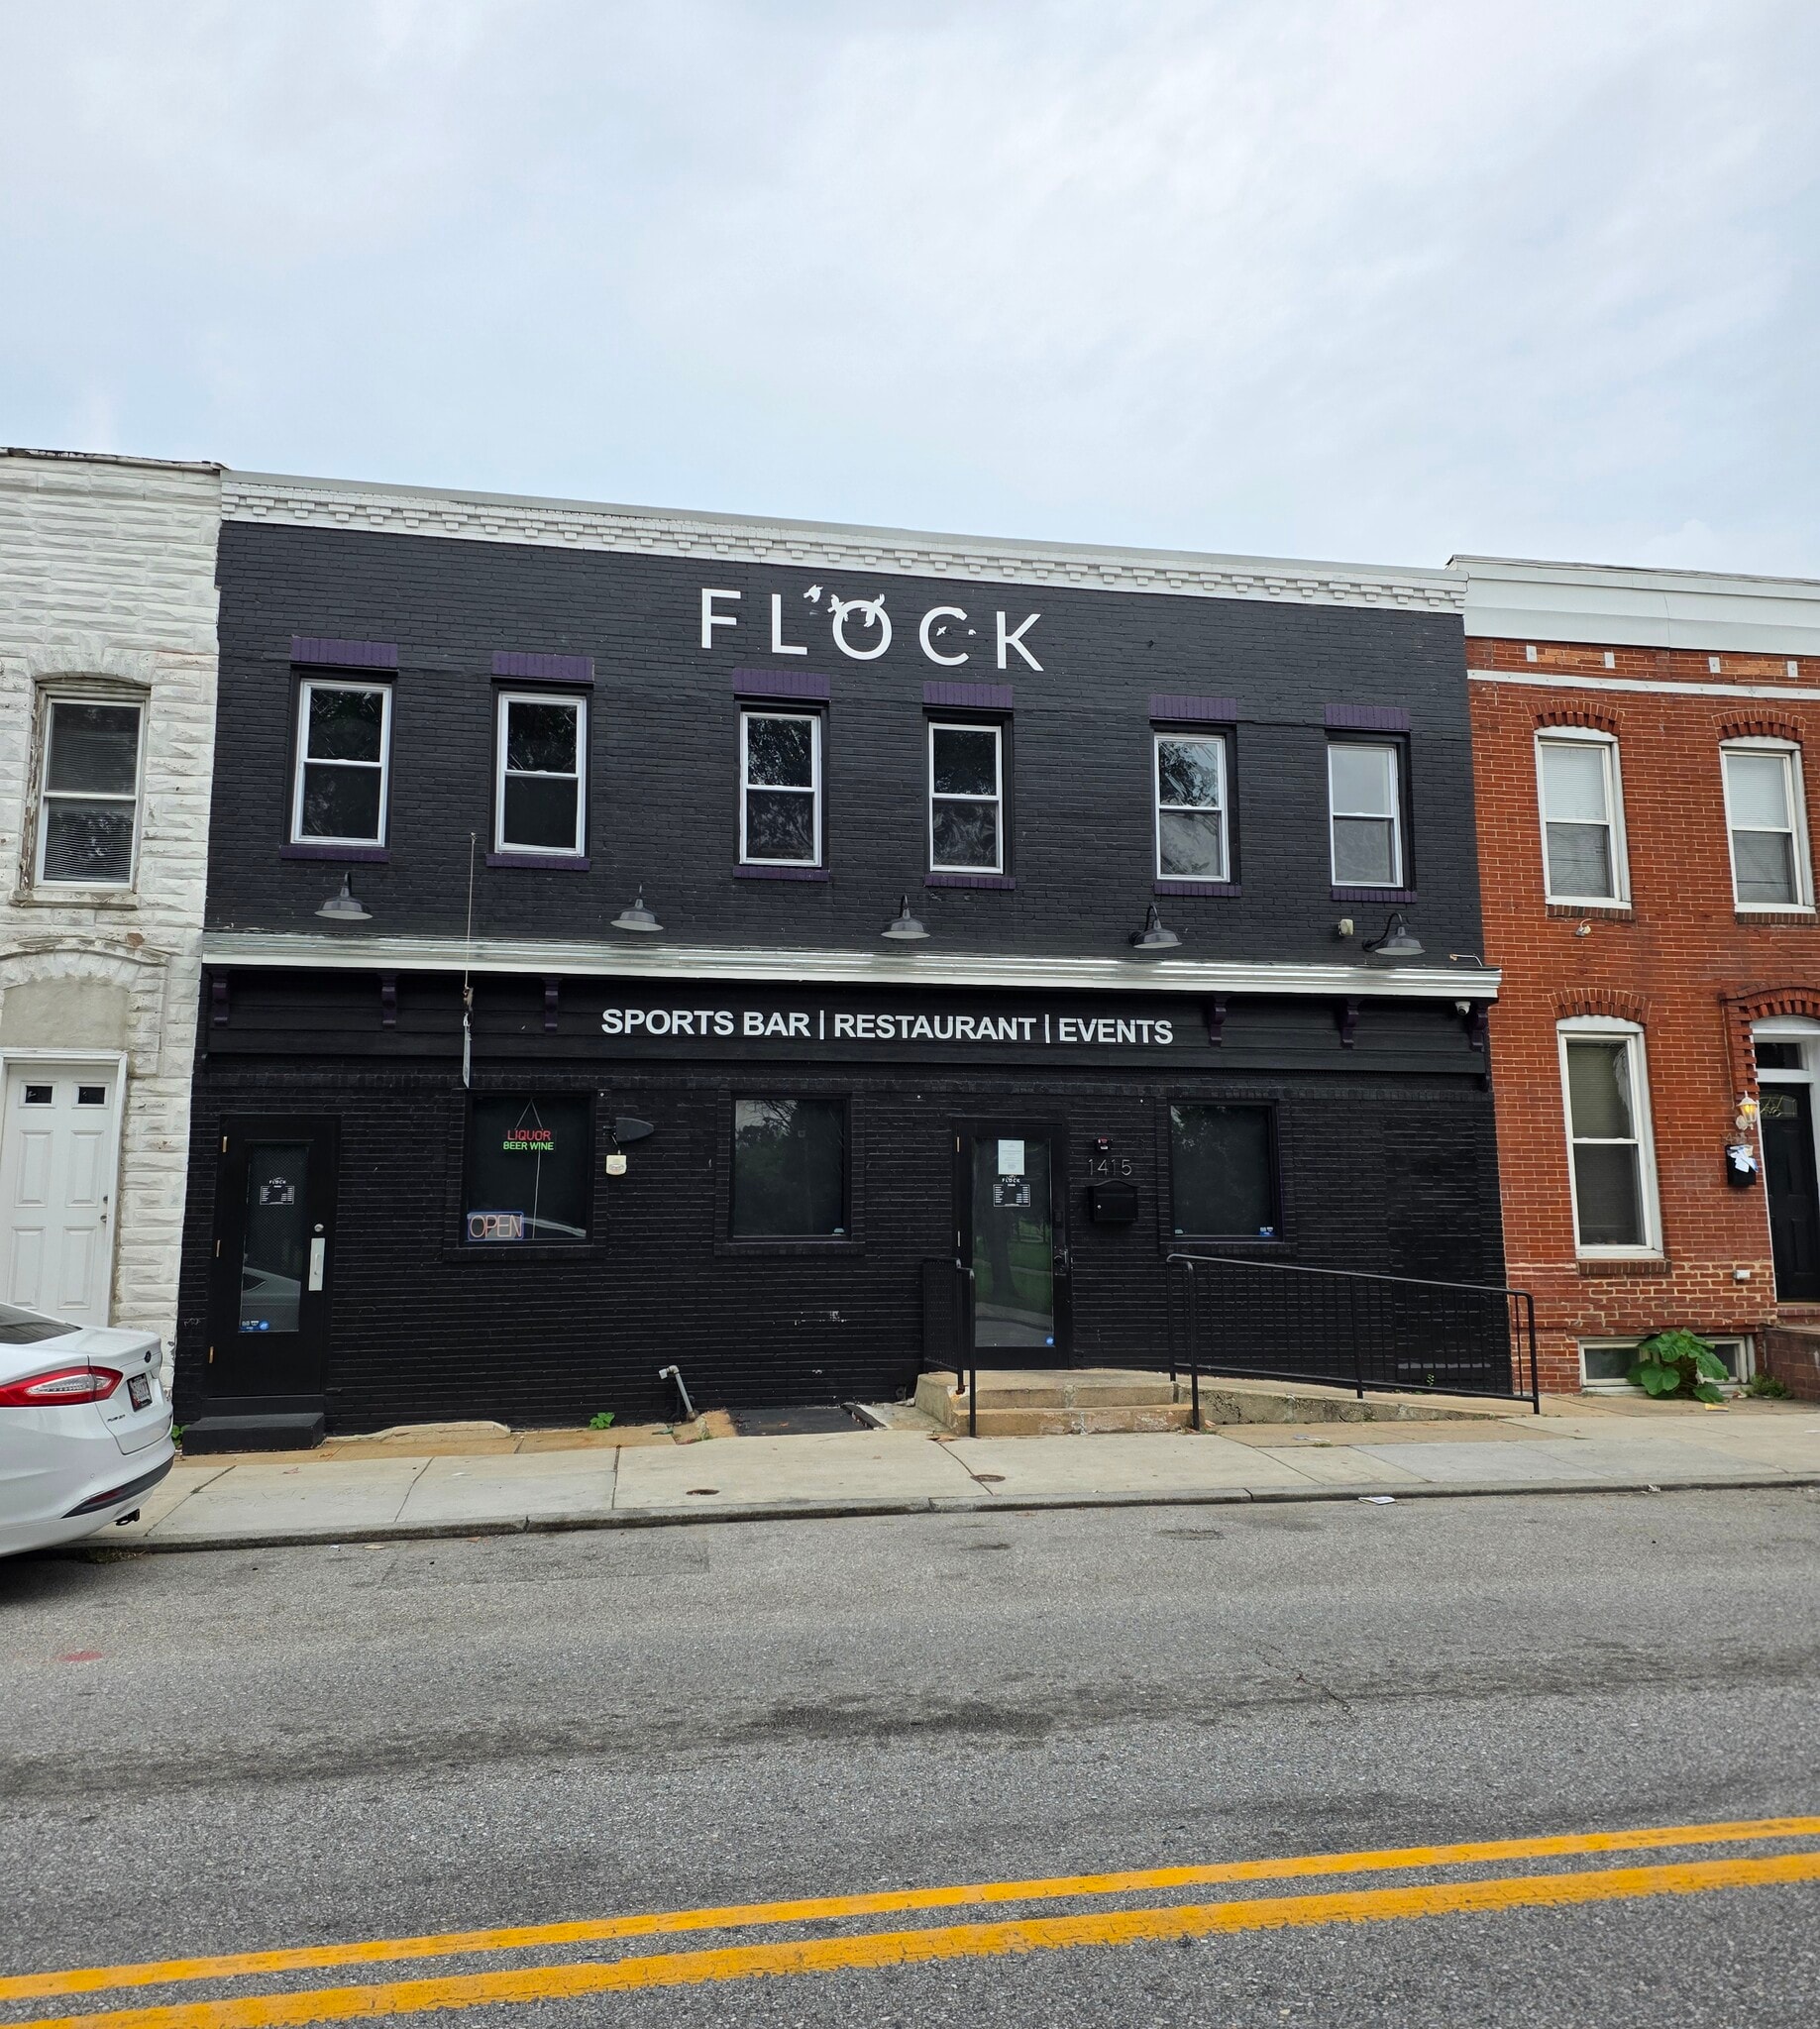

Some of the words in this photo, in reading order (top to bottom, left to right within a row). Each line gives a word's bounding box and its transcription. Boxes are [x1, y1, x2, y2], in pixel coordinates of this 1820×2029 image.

[701, 586, 1044, 672] FLOCK
[601, 1009, 734, 1036] SPORTS
[743, 1011, 811, 1037] BAR
[834, 1014, 1036, 1040] RESTAURANT
[1058, 1017, 1174, 1045] EVENTS
[507, 1129, 552, 1141] LIQUOR
[503, 1141, 528, 1150] BEER
[529, 1141, 555, 1150] WINE
[1088, 1158, 1132, 1176] 1415
[470, 1215, 523, 1238] OPEN
